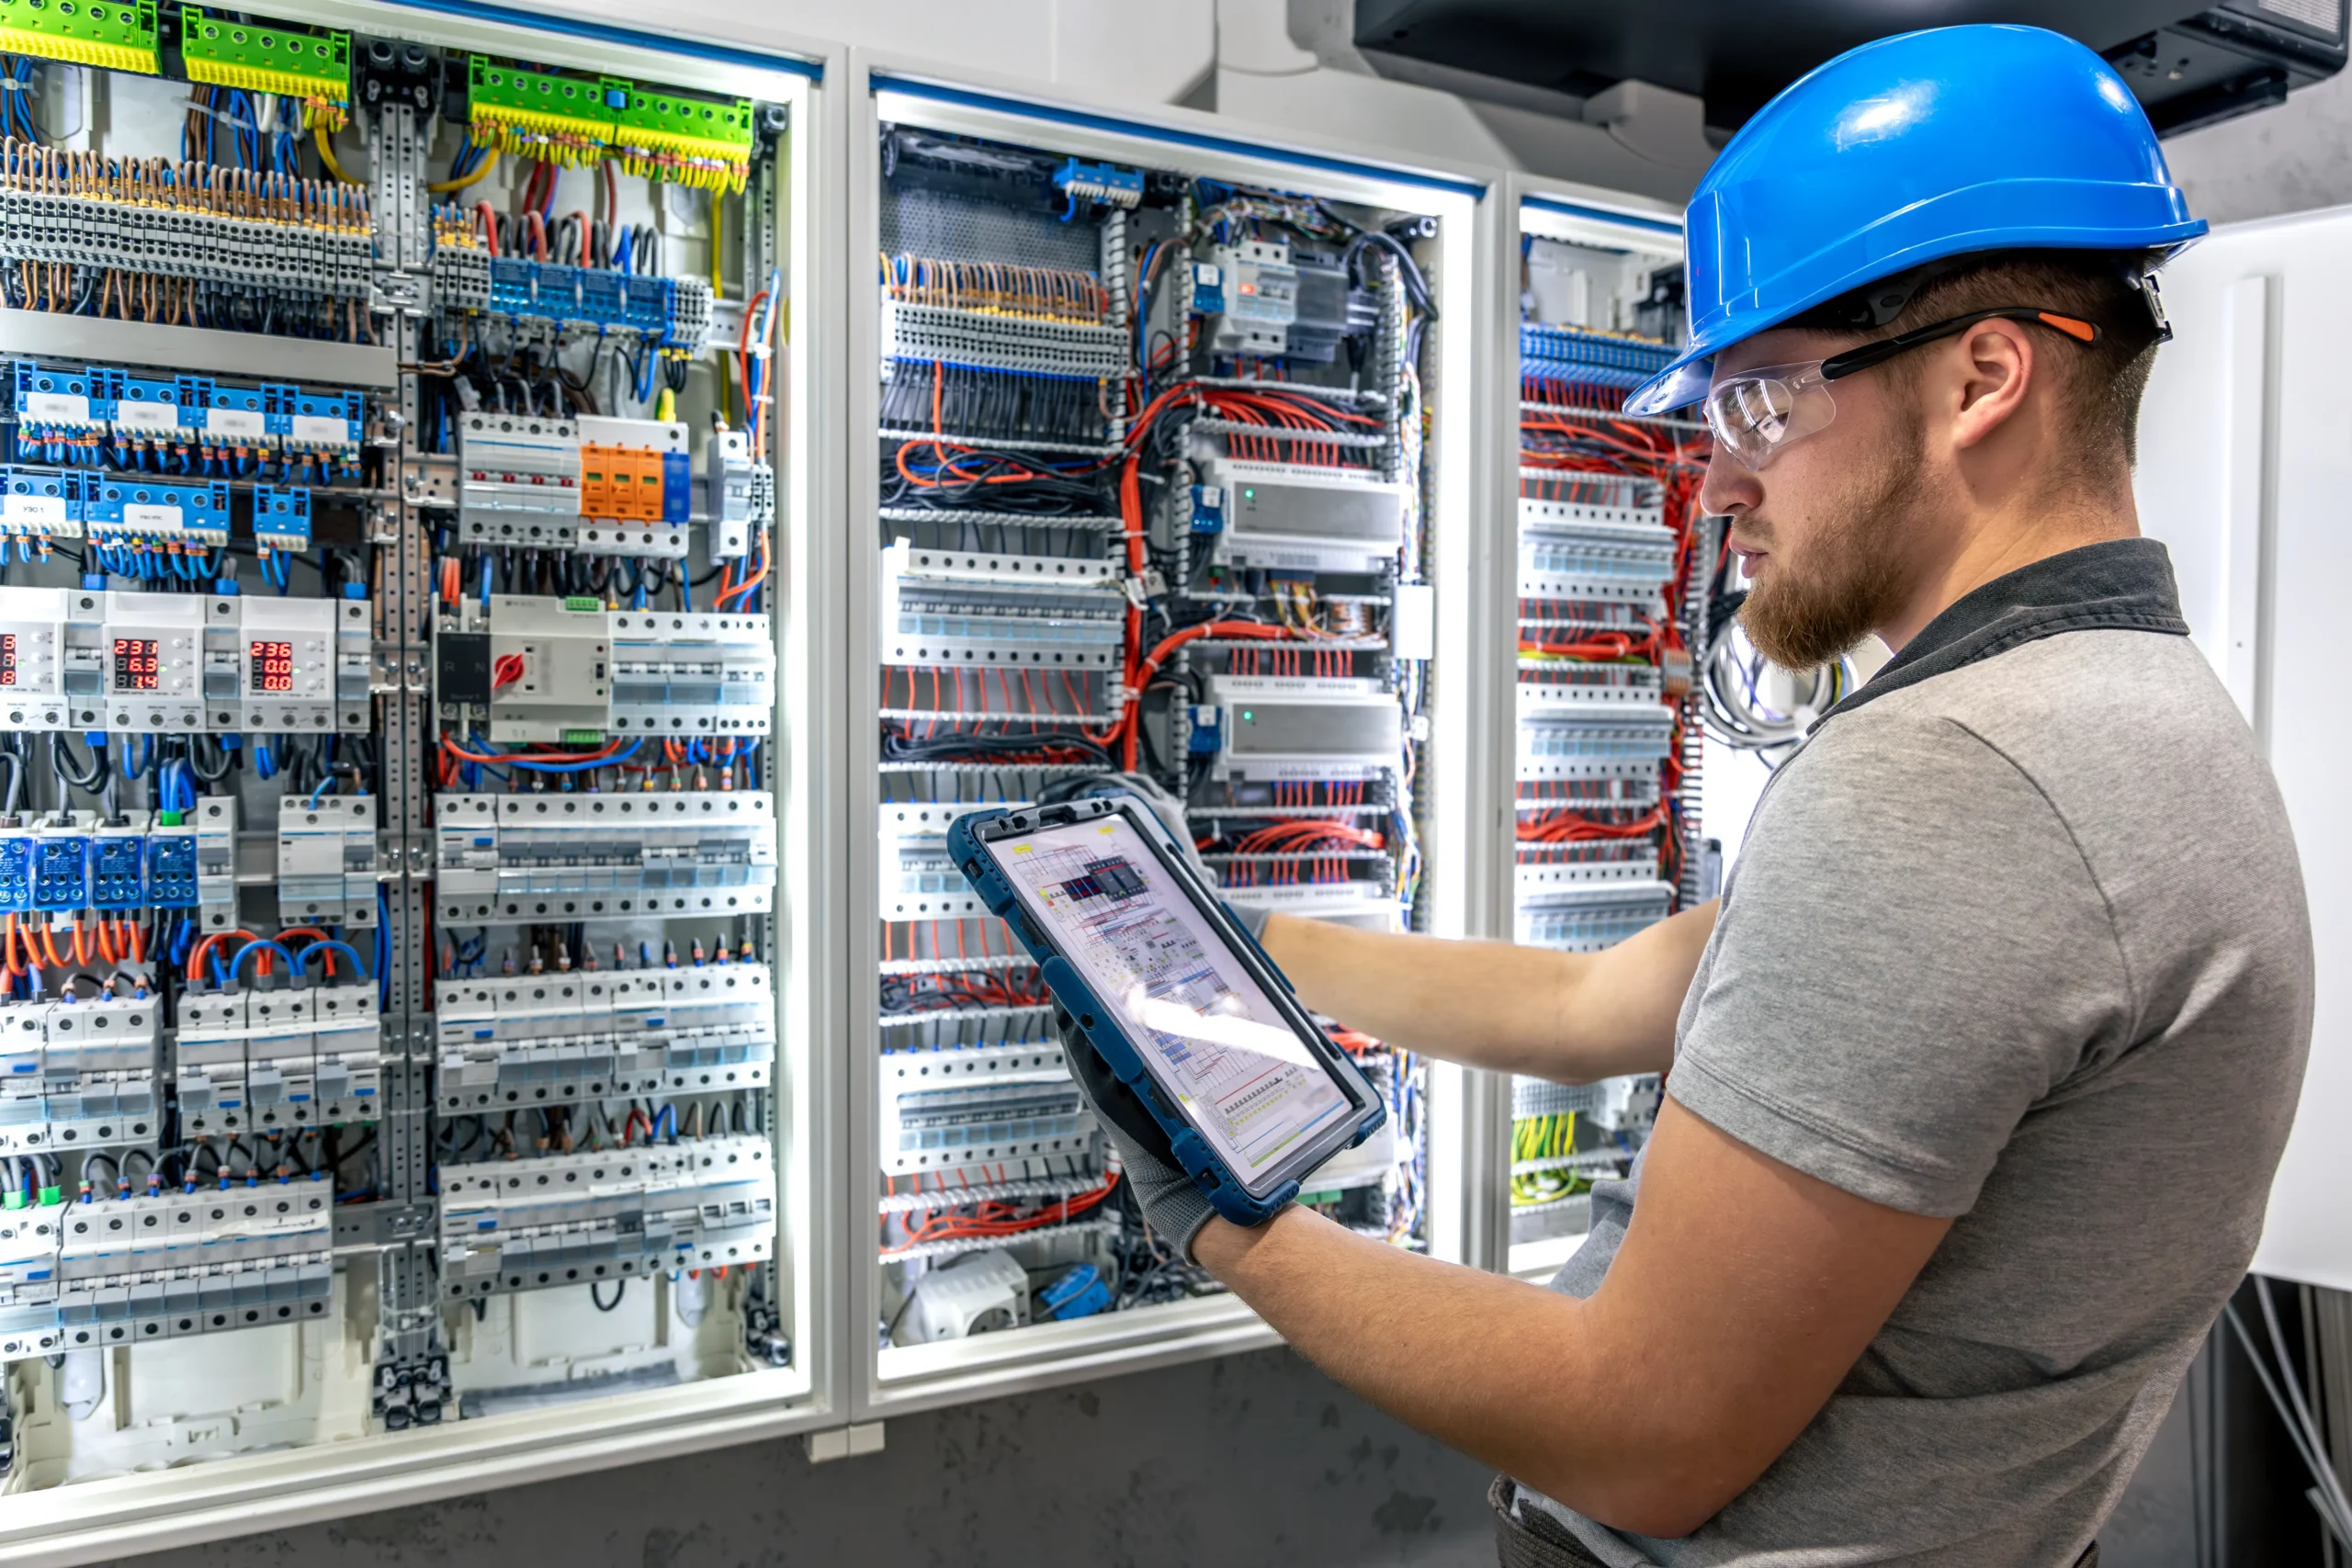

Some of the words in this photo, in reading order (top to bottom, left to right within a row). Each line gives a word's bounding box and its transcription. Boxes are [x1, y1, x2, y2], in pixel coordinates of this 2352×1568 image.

[114, 639, 158, 655] 231
[250, 641, 292, 658] 236
[129, 657, 158, 672] 6.3
[264, 659, 292, 674] 0.0
[445, 660, 456, 672] R
[474, 661, 486, 673] N
[136, 675, 158, 690] 1.4
[264, 675, 292, 691] 0.0
